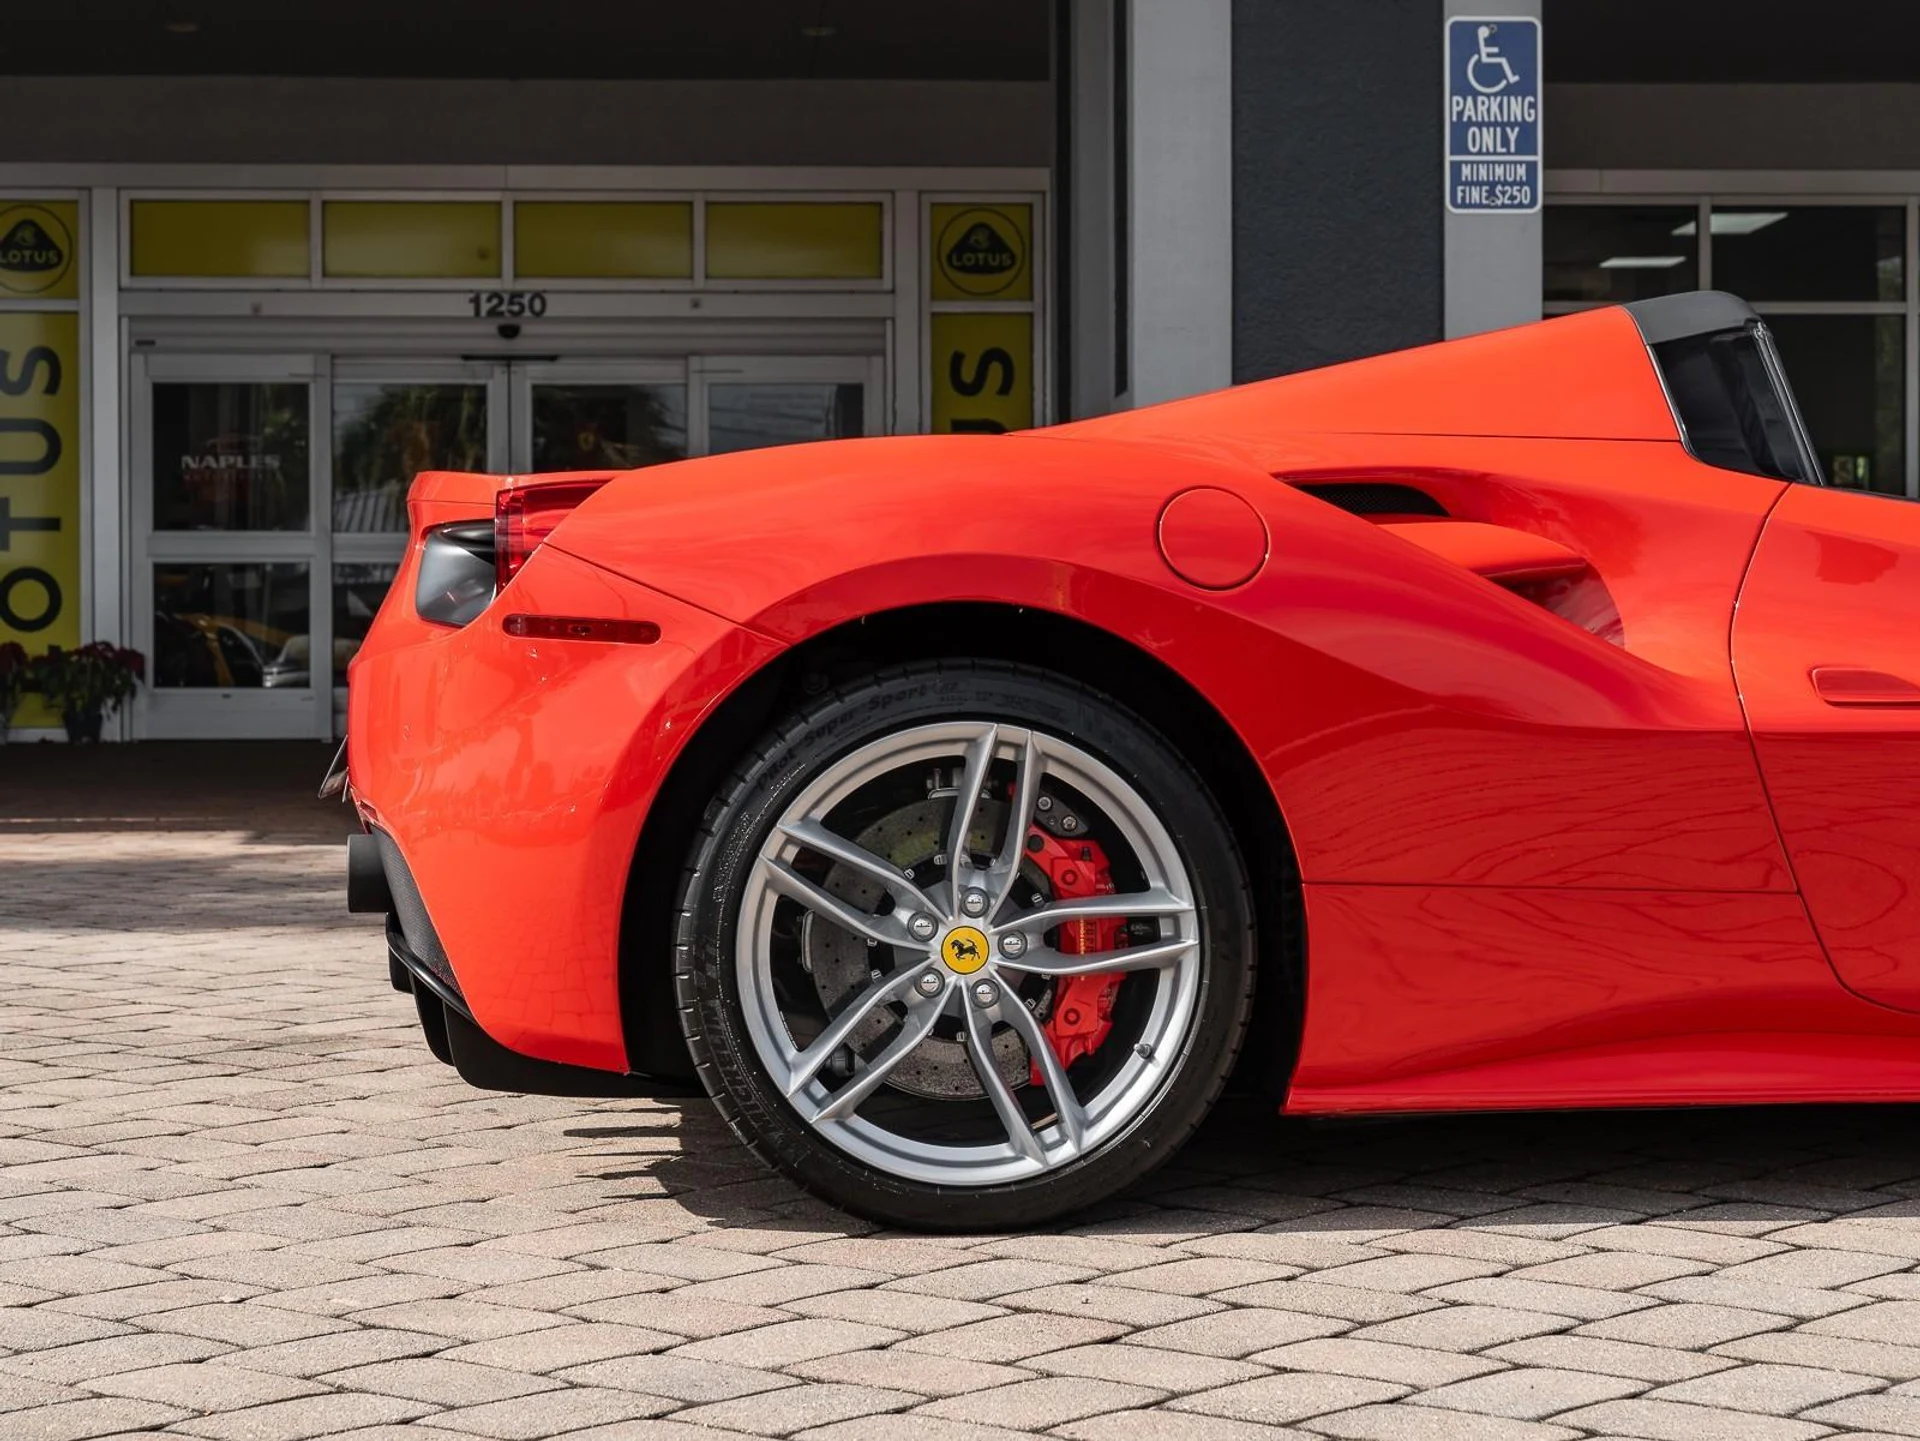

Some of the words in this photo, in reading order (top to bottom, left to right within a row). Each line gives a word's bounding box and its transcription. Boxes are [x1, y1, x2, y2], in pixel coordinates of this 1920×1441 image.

[1452, 96, 1536, 122] PARKING
[1467, 126, 1519, 153] ONLY
[1461, 163, 1527, 182] MINIMUM
[1456, 186, 1490, 205] FINE
[1494, 184, 1531, 205] $250
[952, 252, 1013, 267] LOTUS
[468, 292, 547, 317] 1250
[180, 454, 280, 470] NAPLES
[0, 345, 62, 655] OTUS
[868, 685, 928, 711] Sport
